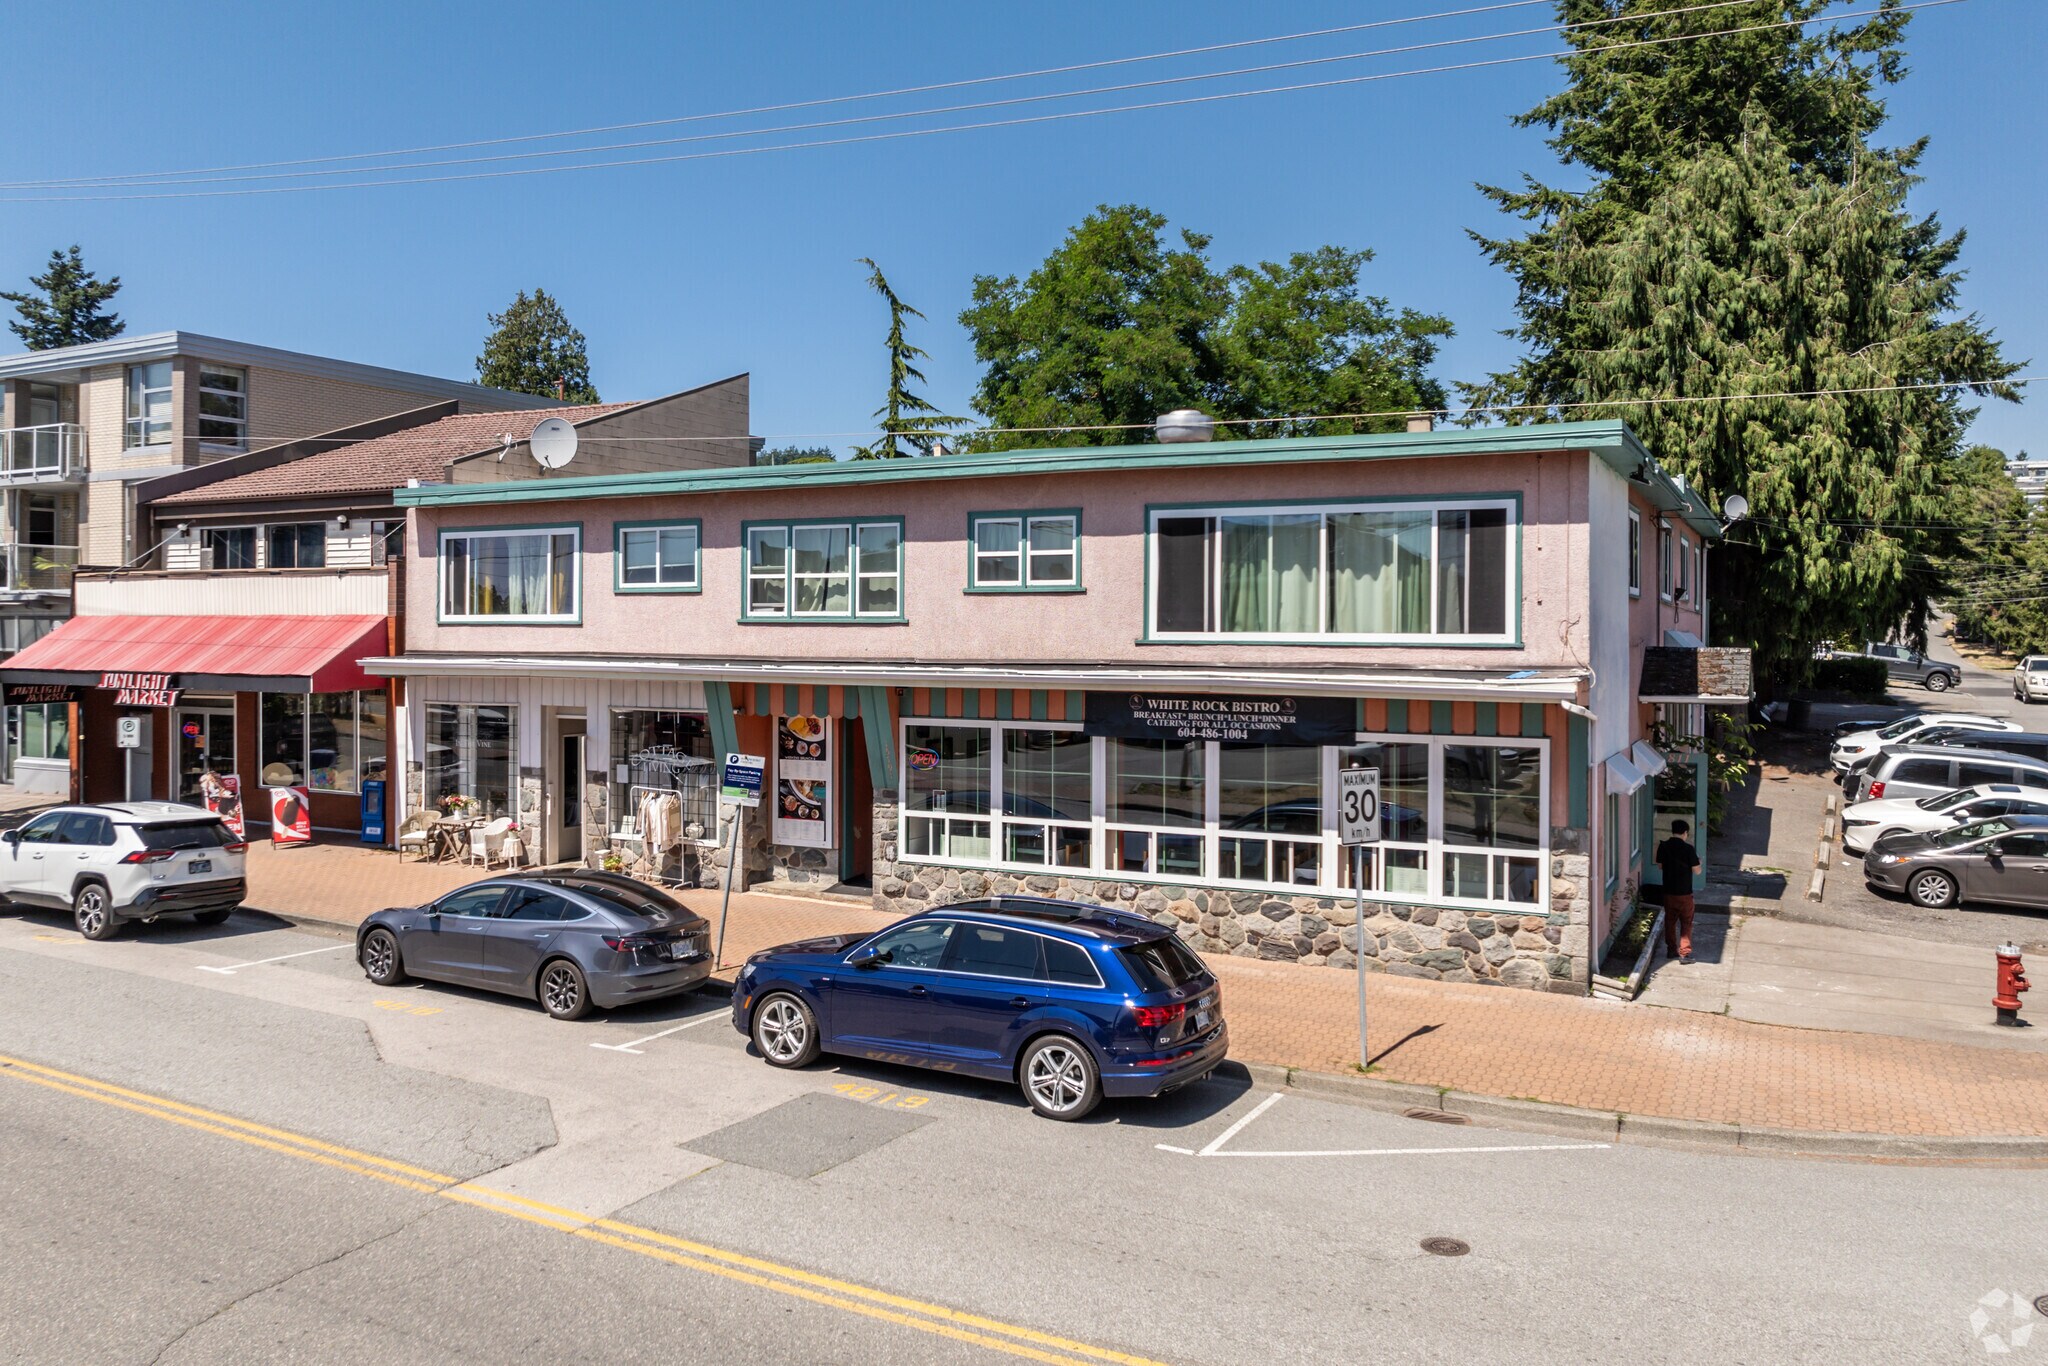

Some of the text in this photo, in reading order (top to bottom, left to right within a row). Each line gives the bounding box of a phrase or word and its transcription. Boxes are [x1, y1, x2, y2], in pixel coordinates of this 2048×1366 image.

[26, 692, 76, 702] MARKET
[115, 688, 179, 706] MARKET
[1146, 699, 1280, 713] WHITE ROCK BISTRO
[1146, 719, 1281, 730] CATERING FOR ALL OCCASIONS
[1177, 727, 1248, 740] 604-486-1004
[911, 753, 937, 766] OPEN
[1343, 774, 1376, 786] MAXIMUM
[1344, 789, 1376, 824] 30
[1351, 827, 1371, 839] km/h
[832, 1083, 930, 1109] 4819
